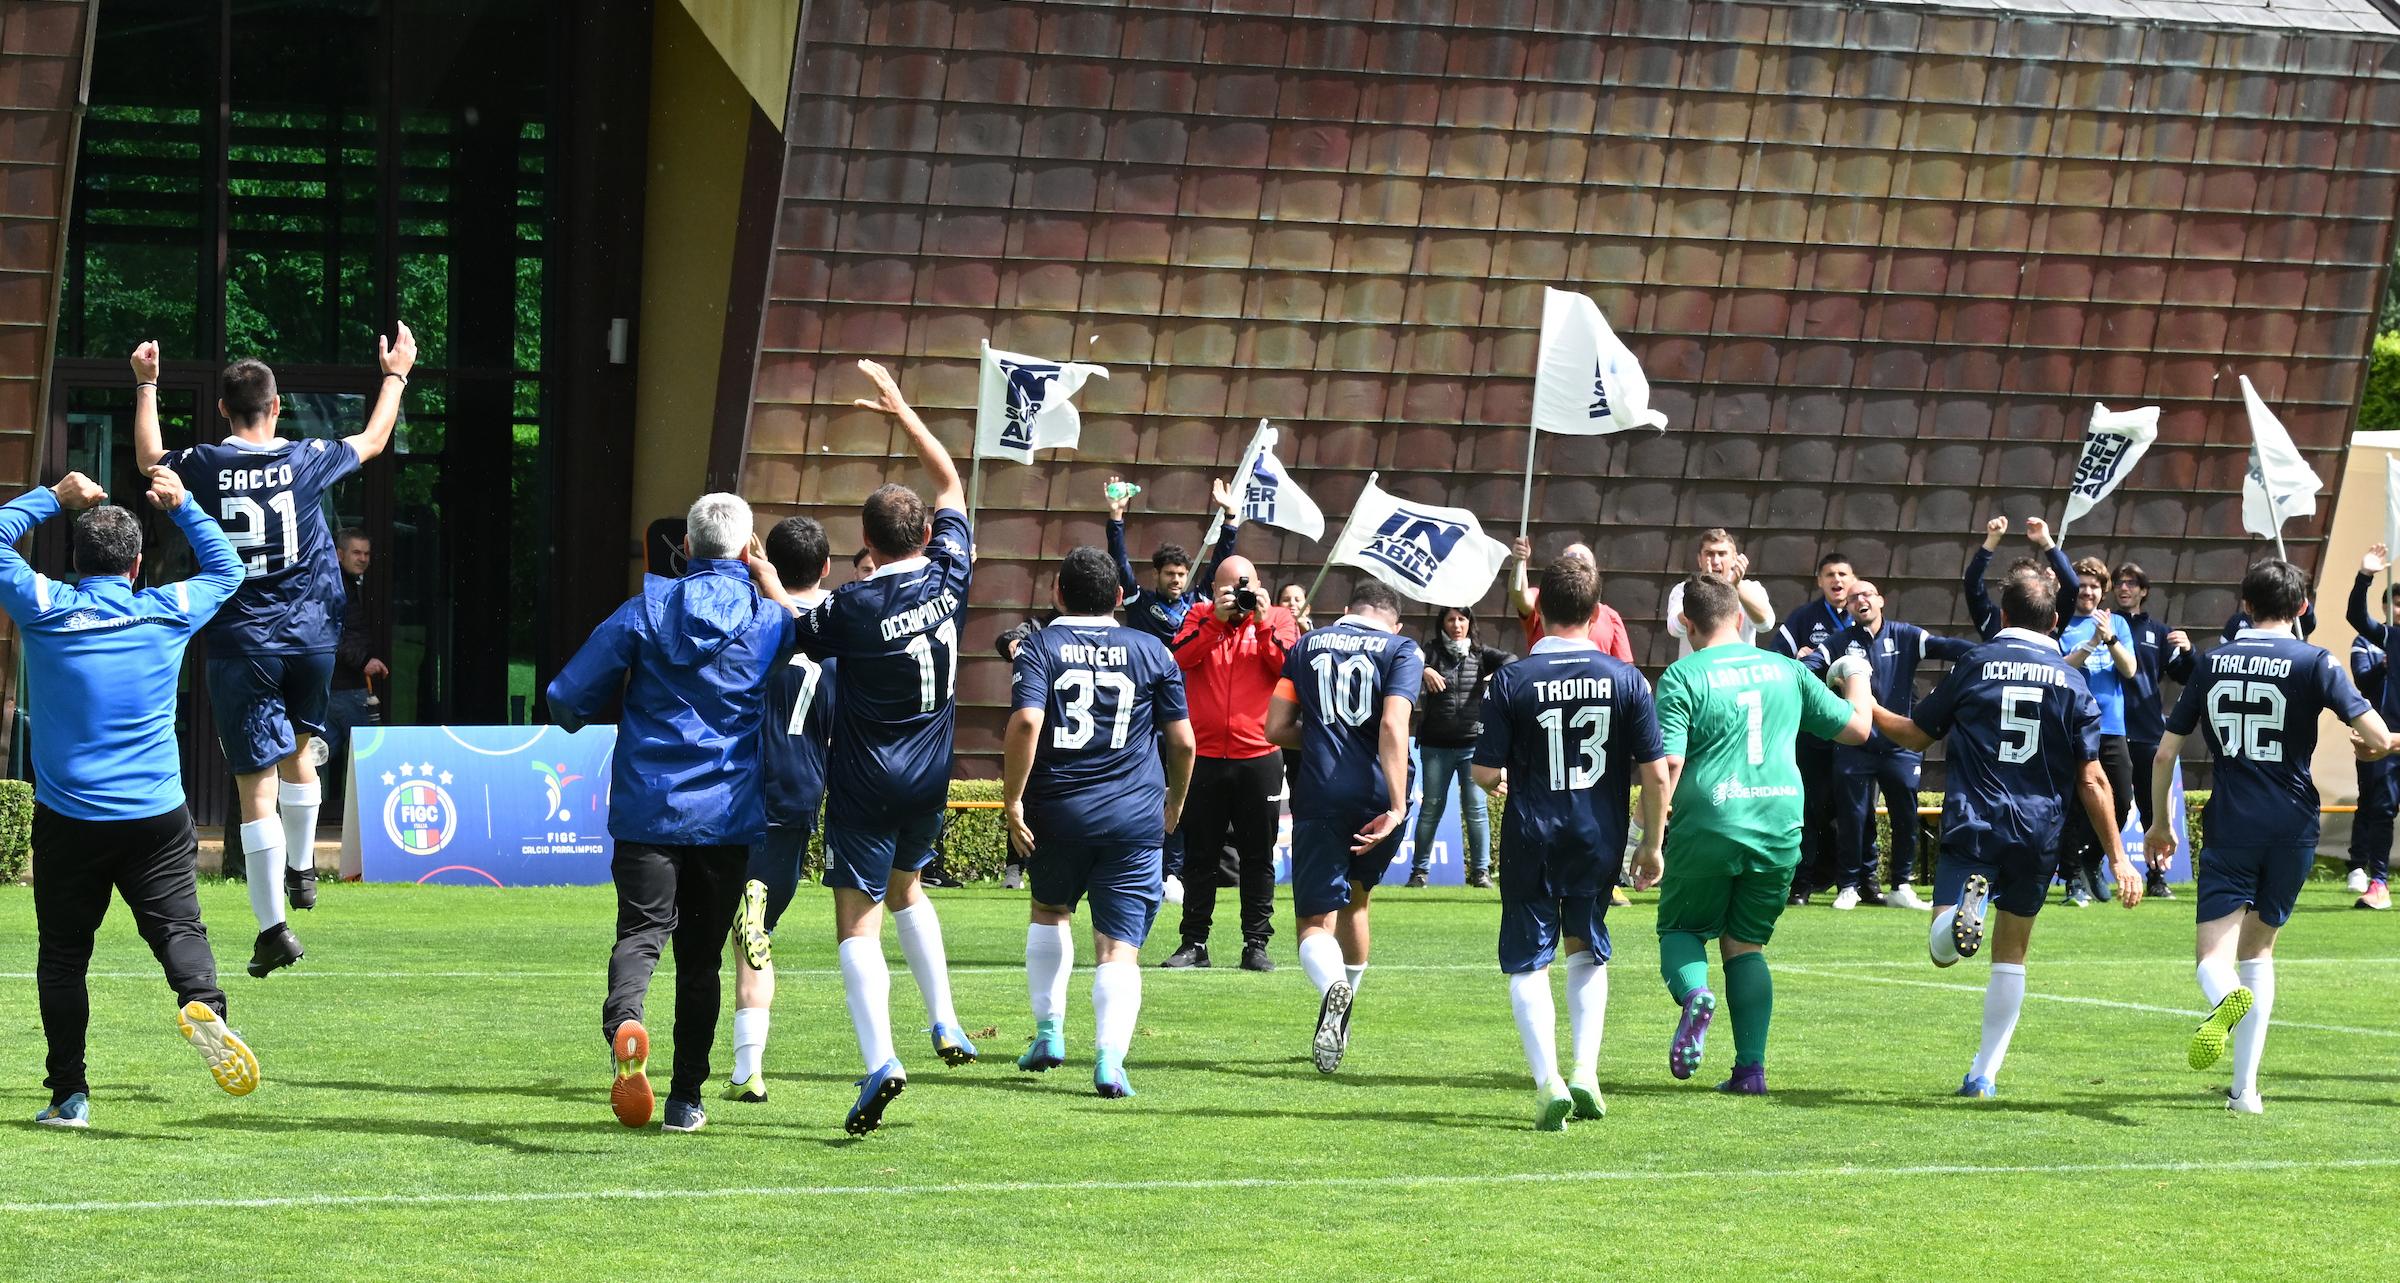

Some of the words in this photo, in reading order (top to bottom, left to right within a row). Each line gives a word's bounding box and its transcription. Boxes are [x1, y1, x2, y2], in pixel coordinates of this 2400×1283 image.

[218, 464, 294, 491] SACCO
[220, 490, 300, 579] 21
[1376, 512, 1466, 564] IN
[1364, 540, 1434, 583] ABILI
[1060, 643, 1129, 667] AUTERI
[1307, 632, 1389, 653] MANGIAFICO
[904, 616, 958, 713] 11
[1707, 663, 1783, 689] LANTERI
[1981, 660, 2055, 684] OCCHIPINTI
[2211, 654, 2293, 679] TRALONGO
[787, 651, 823, 736] 7
[1053, 668, 1136, 750] 37
[1310, 652, 1375, 727] 10
[1533, 678, 1612, 703] TROINA
[1736, 690, 1765, 766] 1
[1998, 685, 2044, 764] 5
[2207, 680, 2288, 763] 62
[1535, 705, 1612, 792] 13
[401, 805, 439, 823] FIGC
[521, 845, 550, 855] CALCIO
[551, 844, 604, 854] PARALIMPICO
[546, 832, 577, 844] FIGC
